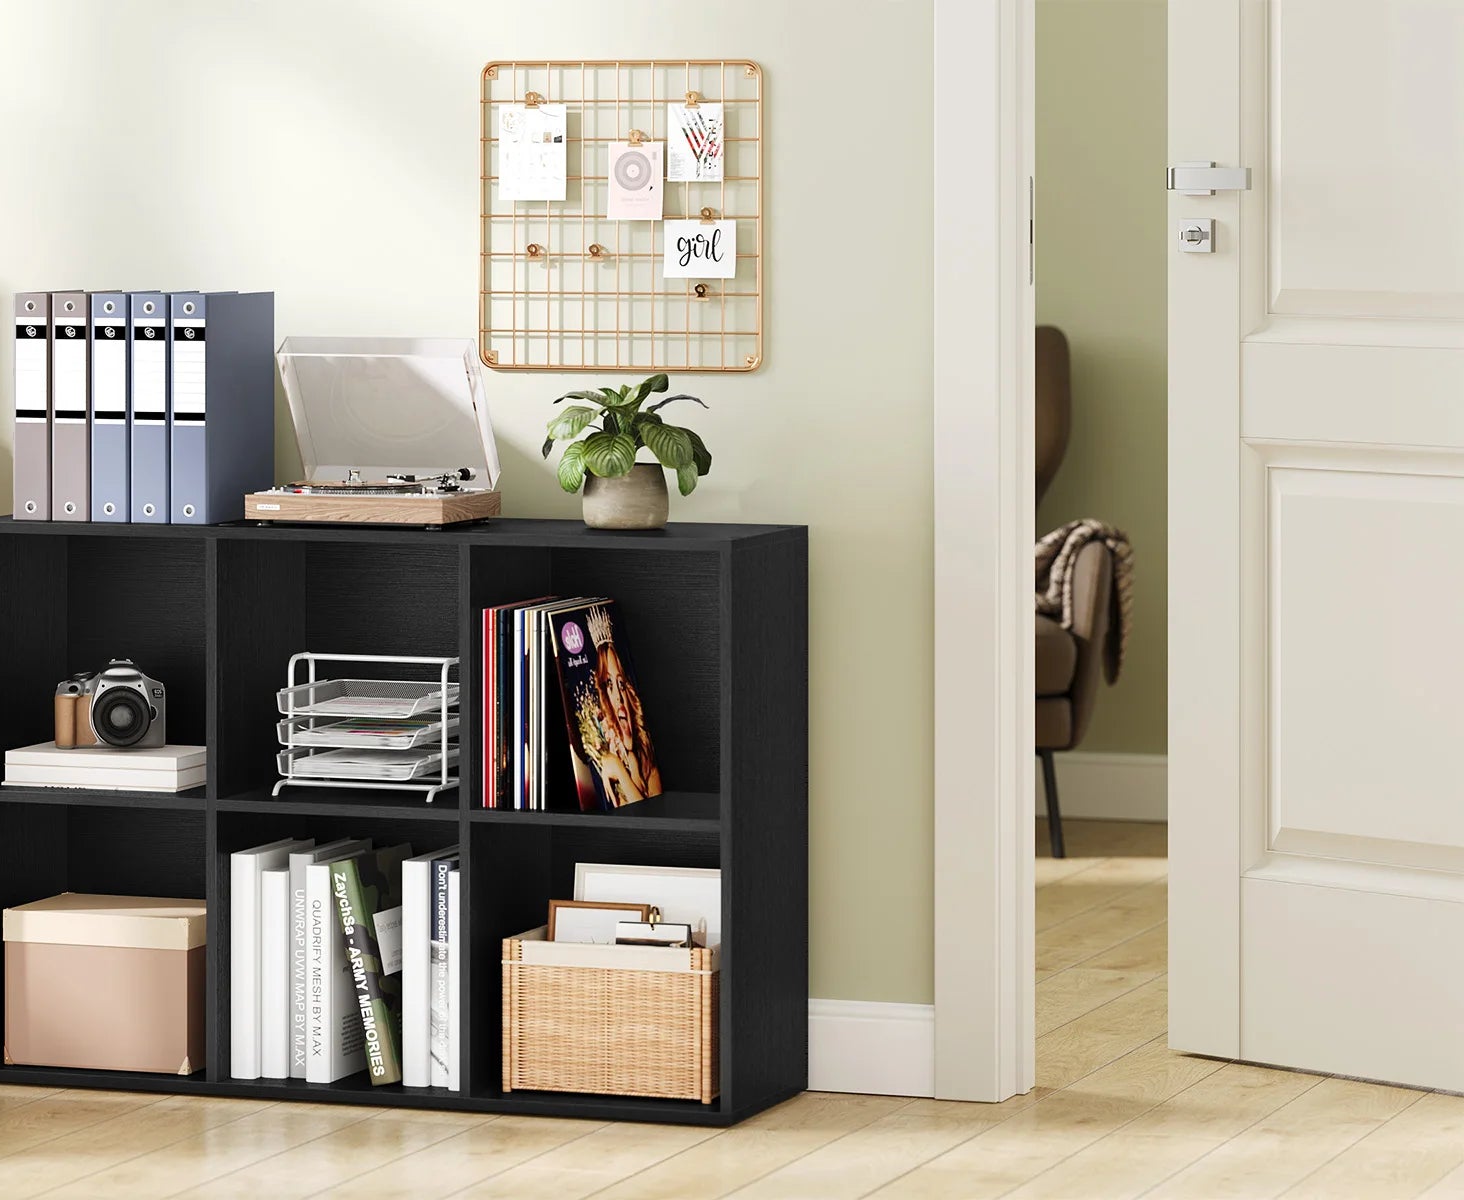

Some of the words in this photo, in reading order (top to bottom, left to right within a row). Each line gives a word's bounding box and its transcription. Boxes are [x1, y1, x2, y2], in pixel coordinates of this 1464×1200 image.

[677, 229, 724, 267] girl
[438, 864, 448, 890] Don't
[295, 889, 305, 947] UNWRAP
[334, 872, 355, 935] ZaychSa
[312, 899, 322, 964] QUADRIFY
[295, 949, 305, 980] UVW
[349, 947, 368, 990] ARMY
[295, 983, 305, 1011] MAP
[312, 967, 322, 1002] MESH
[295, 1014, 305, 1032] BY
[312, 1007, 322, 1023] BY
[312, 1026, 322, 1056] M.AX
[358, 994, 385, 1077] MEMORIES
